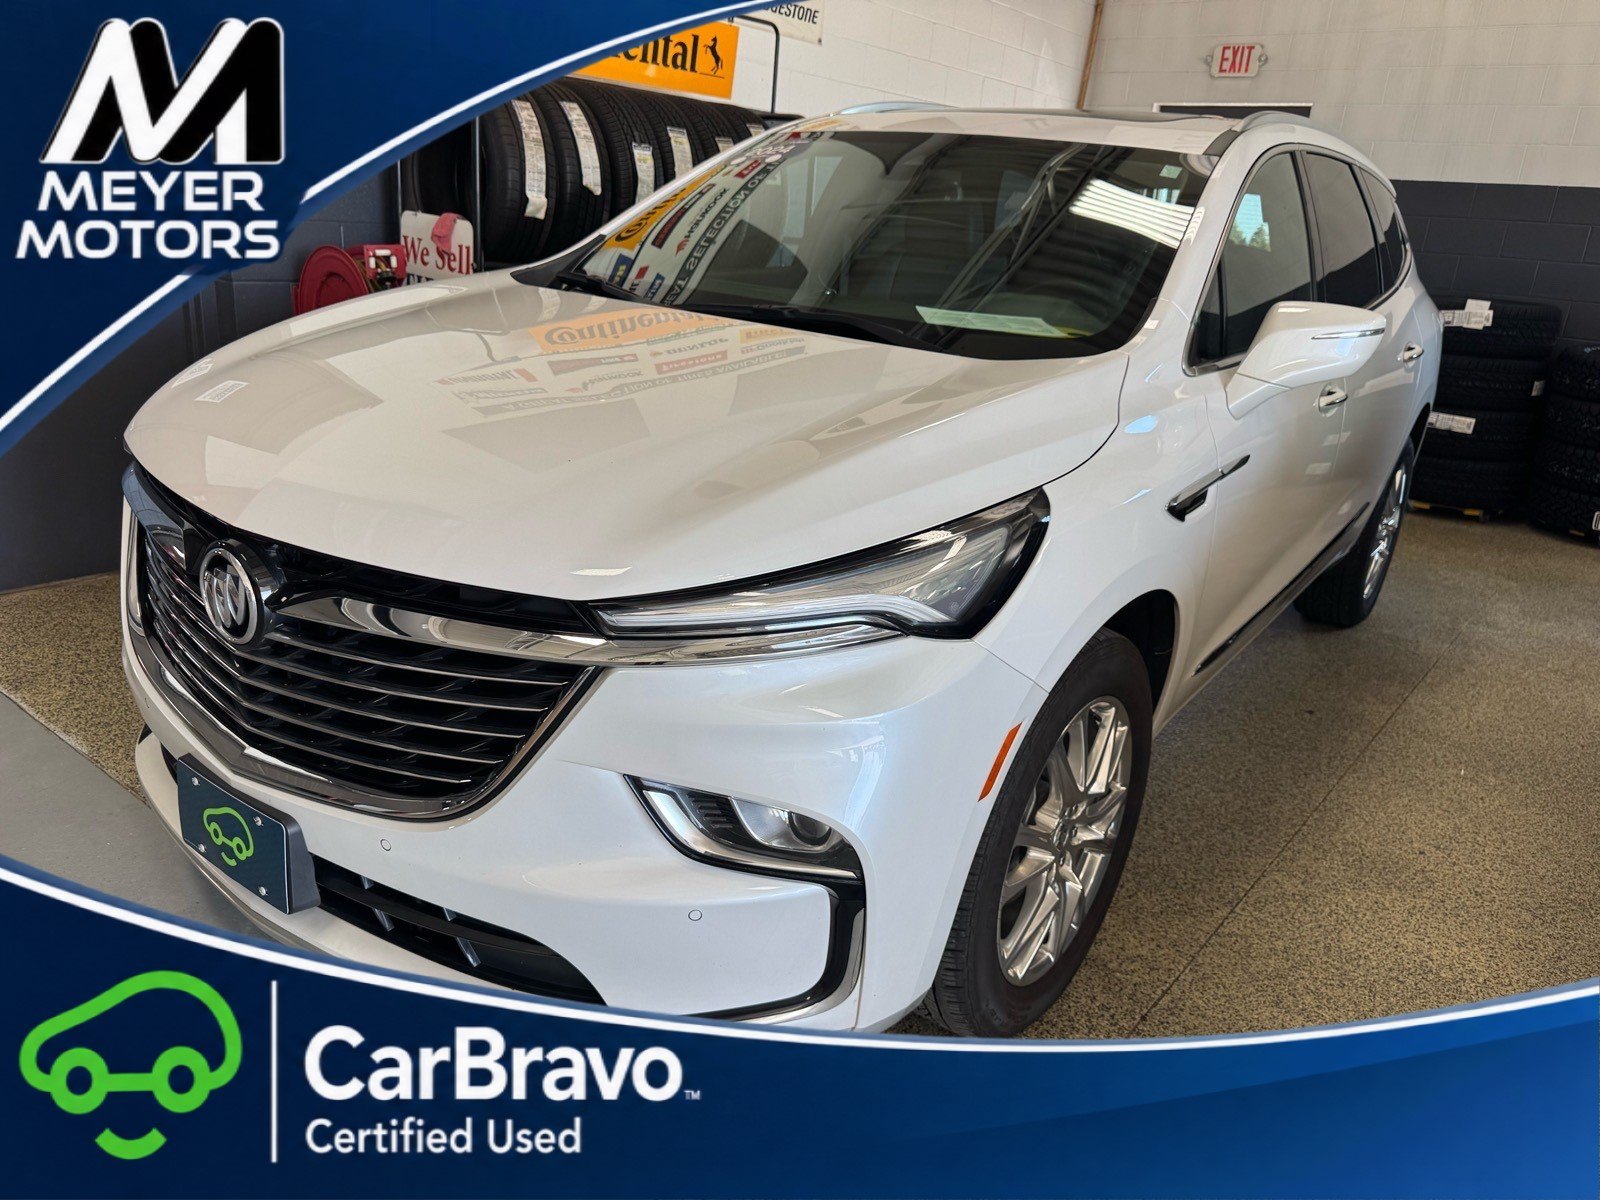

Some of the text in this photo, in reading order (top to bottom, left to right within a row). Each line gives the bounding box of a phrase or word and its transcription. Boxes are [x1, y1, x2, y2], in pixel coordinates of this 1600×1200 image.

[1218, 46, 1255, 74] EXIT
[403, 234, 471, 275] We Sell
